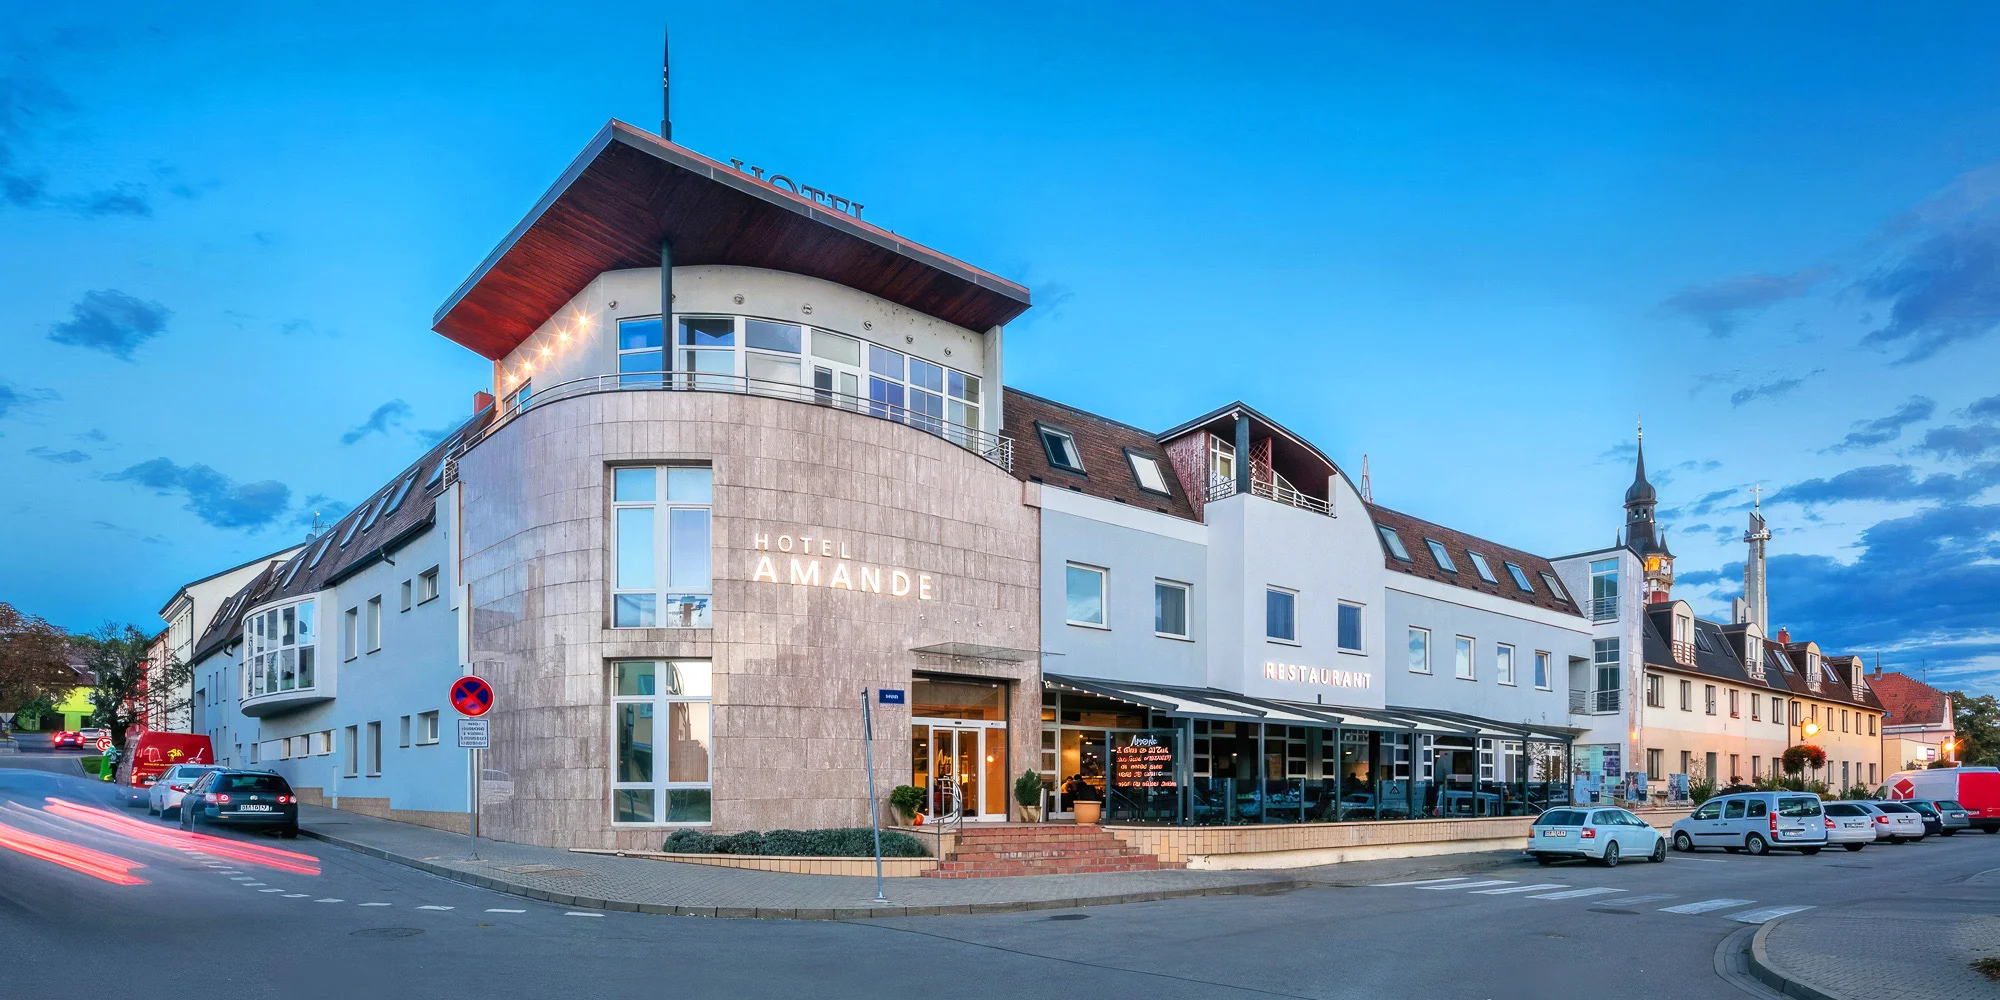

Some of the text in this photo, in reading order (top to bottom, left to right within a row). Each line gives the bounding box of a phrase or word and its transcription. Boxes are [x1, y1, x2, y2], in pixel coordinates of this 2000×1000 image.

[755, 533, 851, 559] HOTEL
[752, 555, 932, 600] AMANDE
[1264, 662, 1372, 690] RESTAURANT
